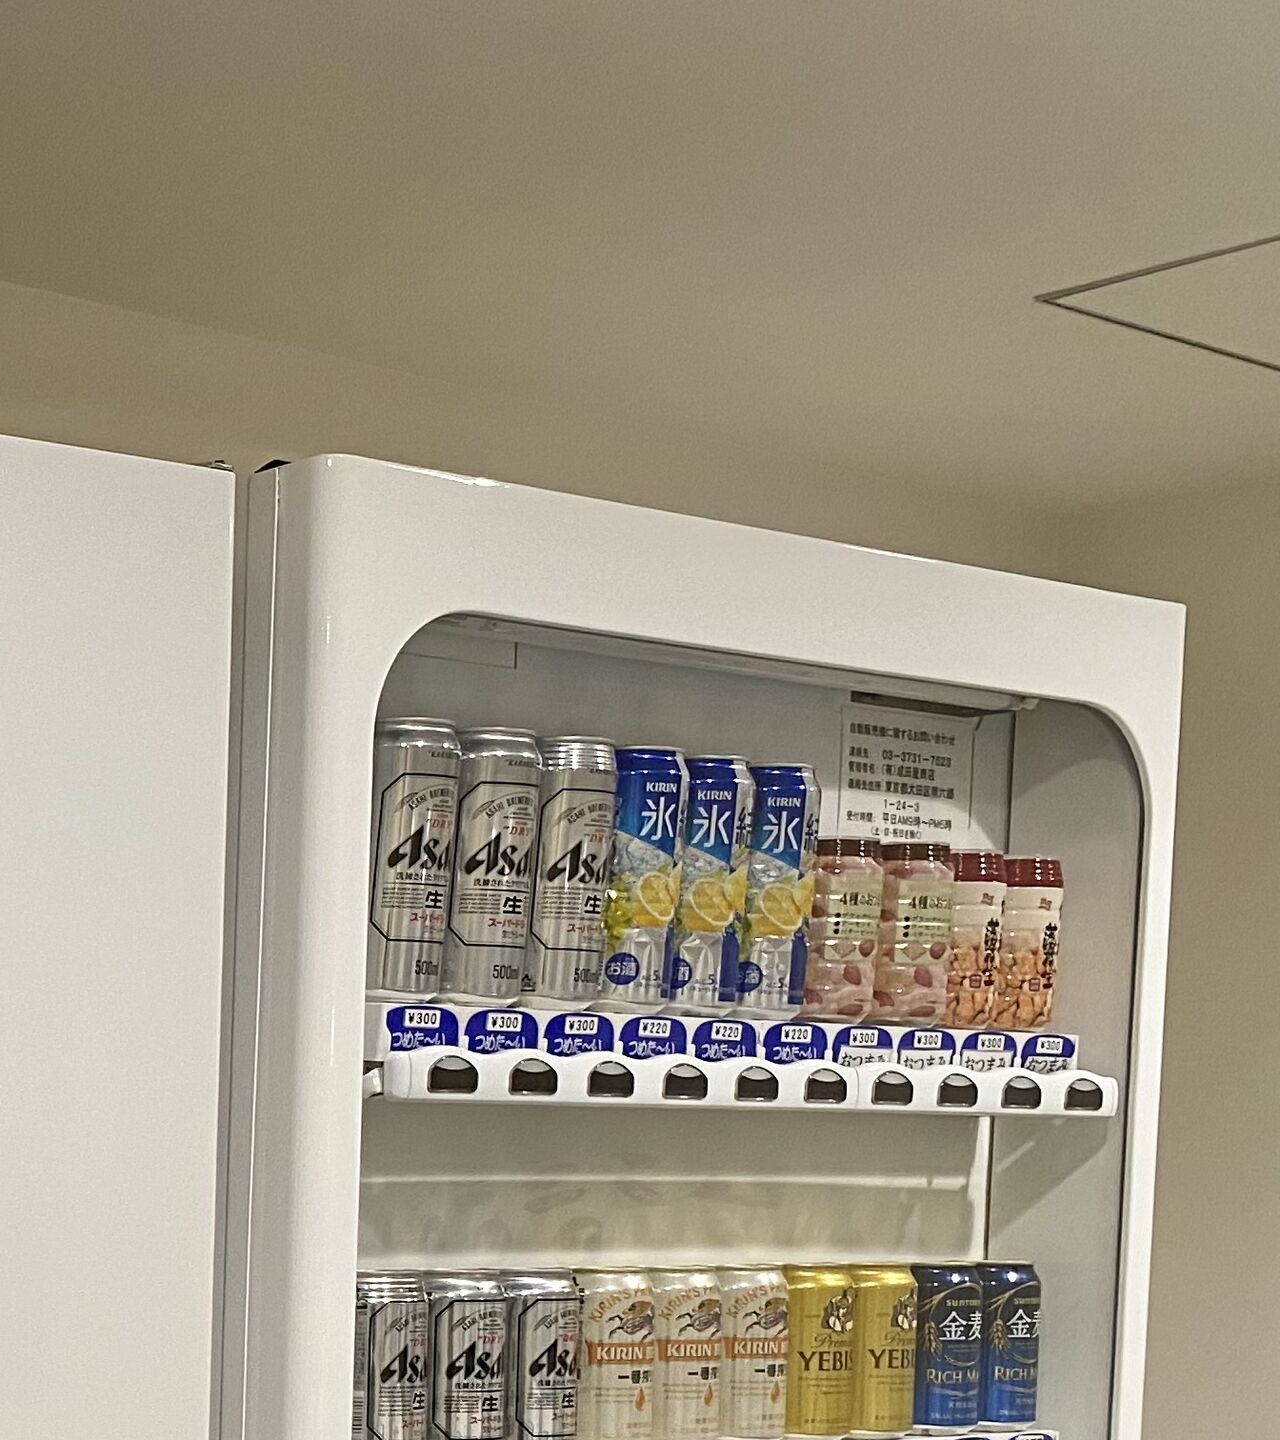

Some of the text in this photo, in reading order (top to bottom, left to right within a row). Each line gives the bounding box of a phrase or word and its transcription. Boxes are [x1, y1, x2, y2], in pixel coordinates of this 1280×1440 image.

[646, 782, 677, 794] KIRIN
[767, 797, 801, 808] KIRIN
[503, 895, 522, 914] 生
[408, 1012, 437, 1025] ¥300
[642, 1022, 667, 1034] ¥220
[667, 1343, 713, 1357] KIRIN
[926, 1368, 962, 1383] RICH
